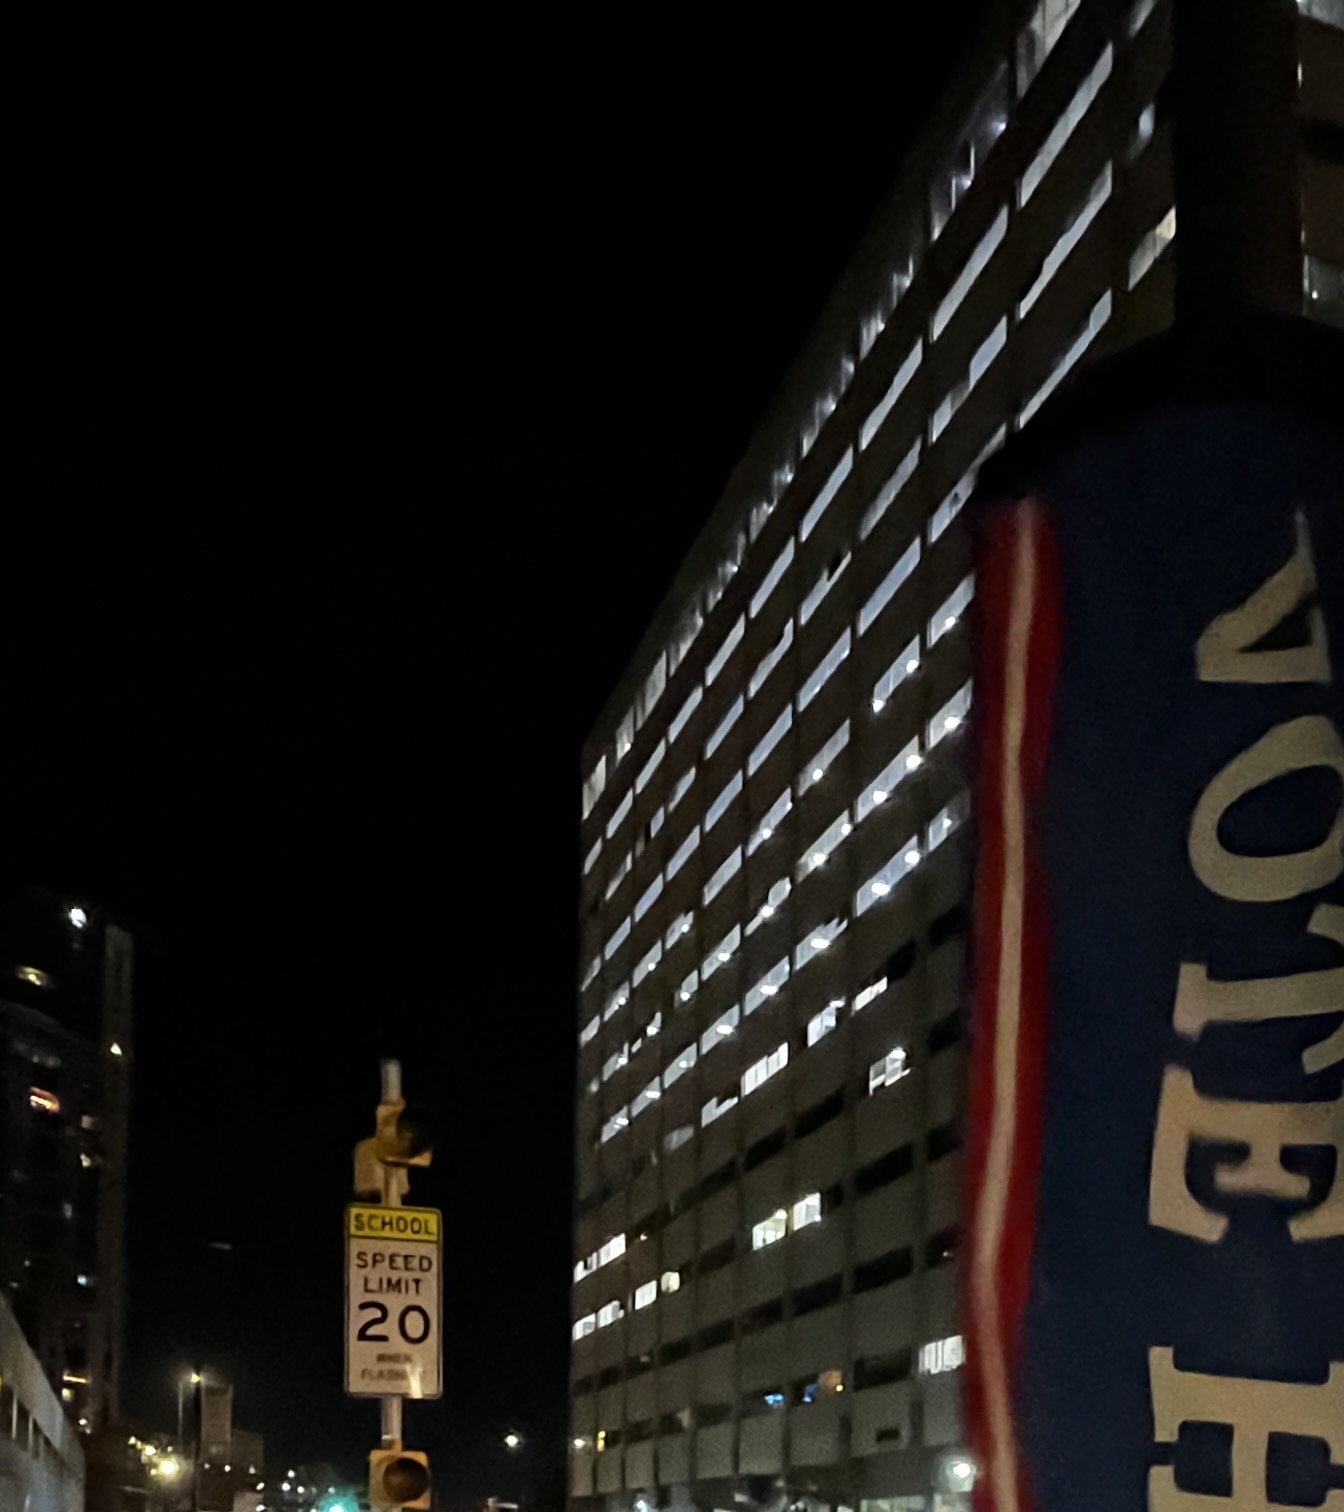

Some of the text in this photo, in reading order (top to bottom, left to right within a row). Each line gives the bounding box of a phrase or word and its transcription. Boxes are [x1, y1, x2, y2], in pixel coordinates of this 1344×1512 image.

[354, 1213, 435, 1236] SCHOOL
[356, 1251, 433, 1273] SPEED
[363, 1275, 423, 1295] LIMIT
[357, 1301, 431, 1345] 20
